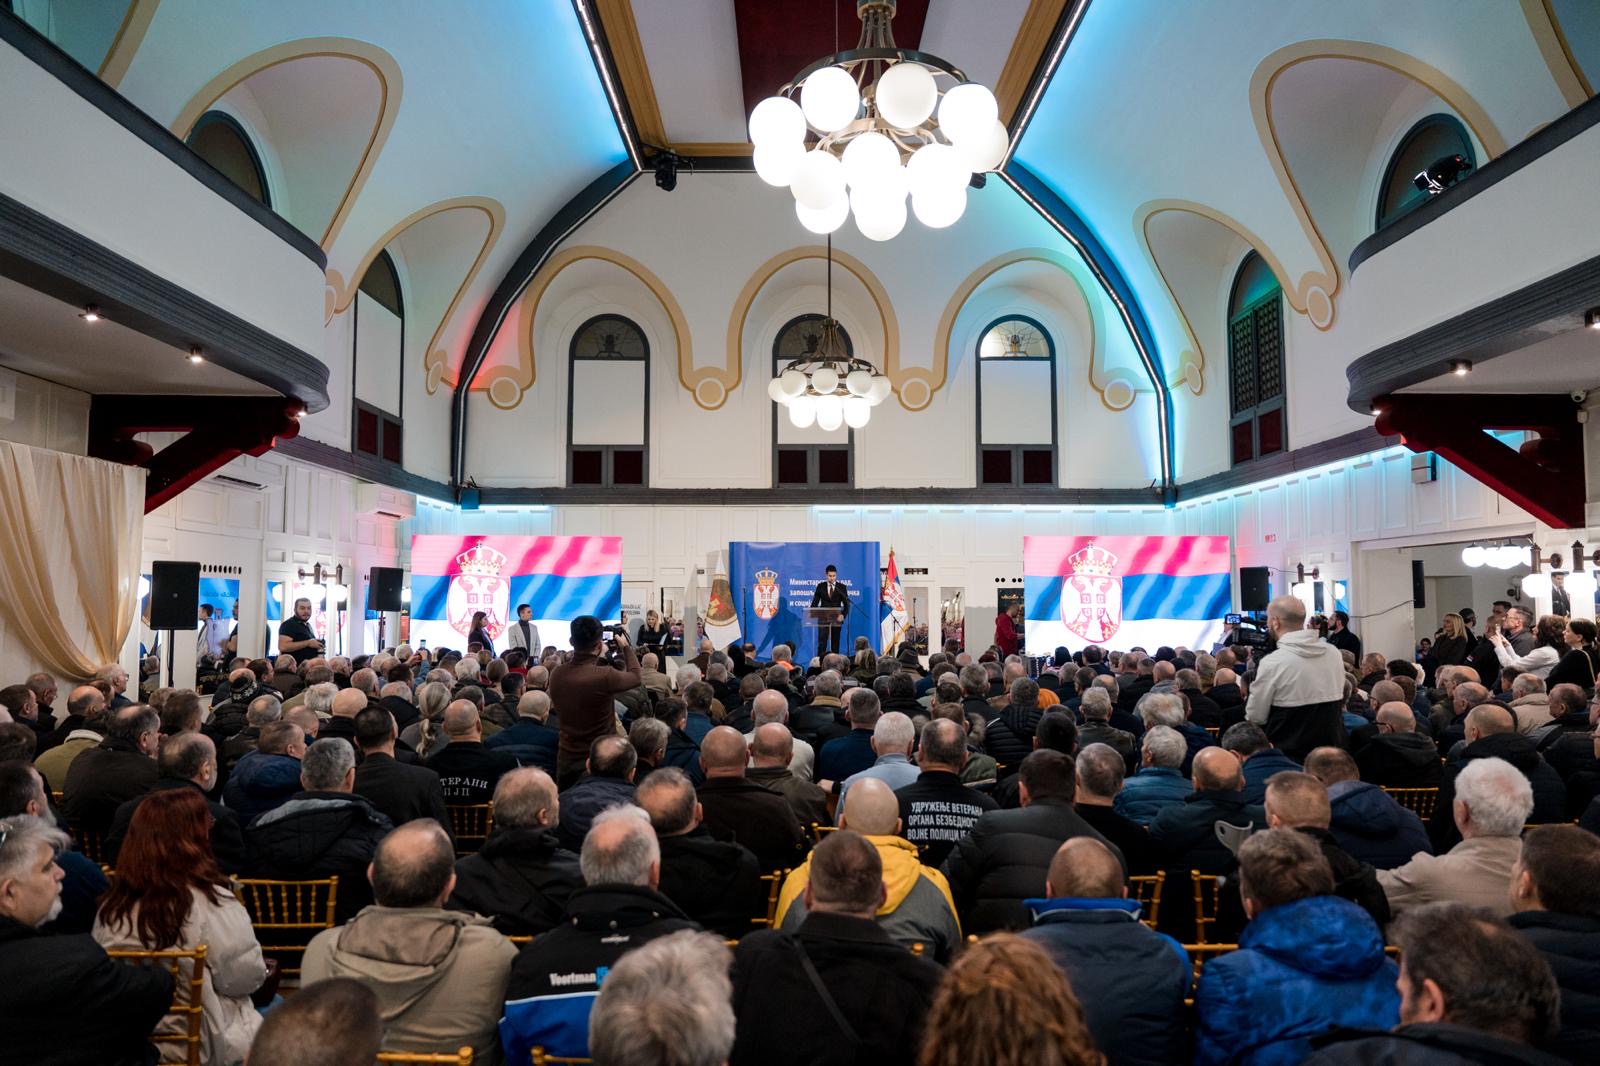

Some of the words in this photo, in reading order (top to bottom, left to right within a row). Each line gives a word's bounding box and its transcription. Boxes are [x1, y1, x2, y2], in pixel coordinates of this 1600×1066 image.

[440, 777, 488, 788] ТЕРАНИ
[911, 801, 951, 813] УДРУЖЕЊЕ
[951, 802, 983, 816] ВЕТЕРАНА
[908, 814, 935, 826] ОРГАНА
[935, 815, 978, 828] БЕЗБЕДНОСТ
[907, 828, 929, 840] ВОЈНЕ
[549, 972, 597, 986] Voortman
